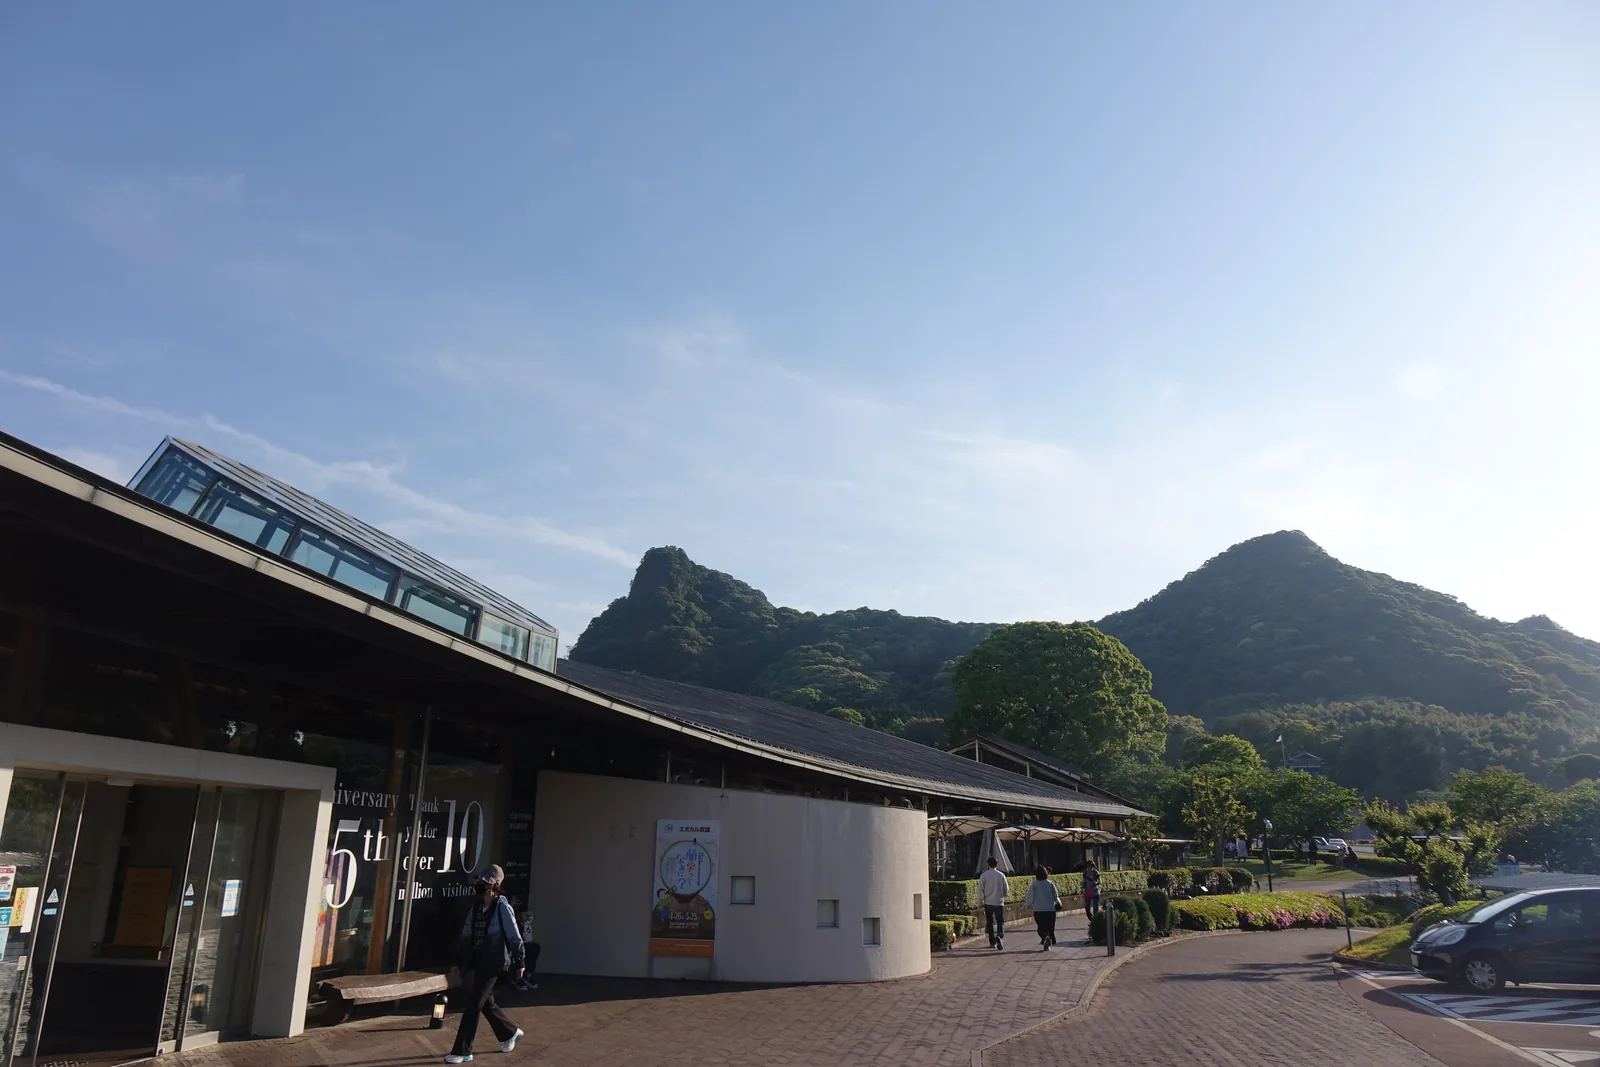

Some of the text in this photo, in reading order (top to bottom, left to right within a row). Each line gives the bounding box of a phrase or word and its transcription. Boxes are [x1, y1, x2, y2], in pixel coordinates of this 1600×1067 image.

[333, 782, 400, 816] iversary
[408, 794, 440, 813] Tank
[423, 820, 438, 839] for
[436, 799, 485, 874] 10
[326, 816, 390, 909] 5th
[397, 881, 477, 901] mllion visitors
